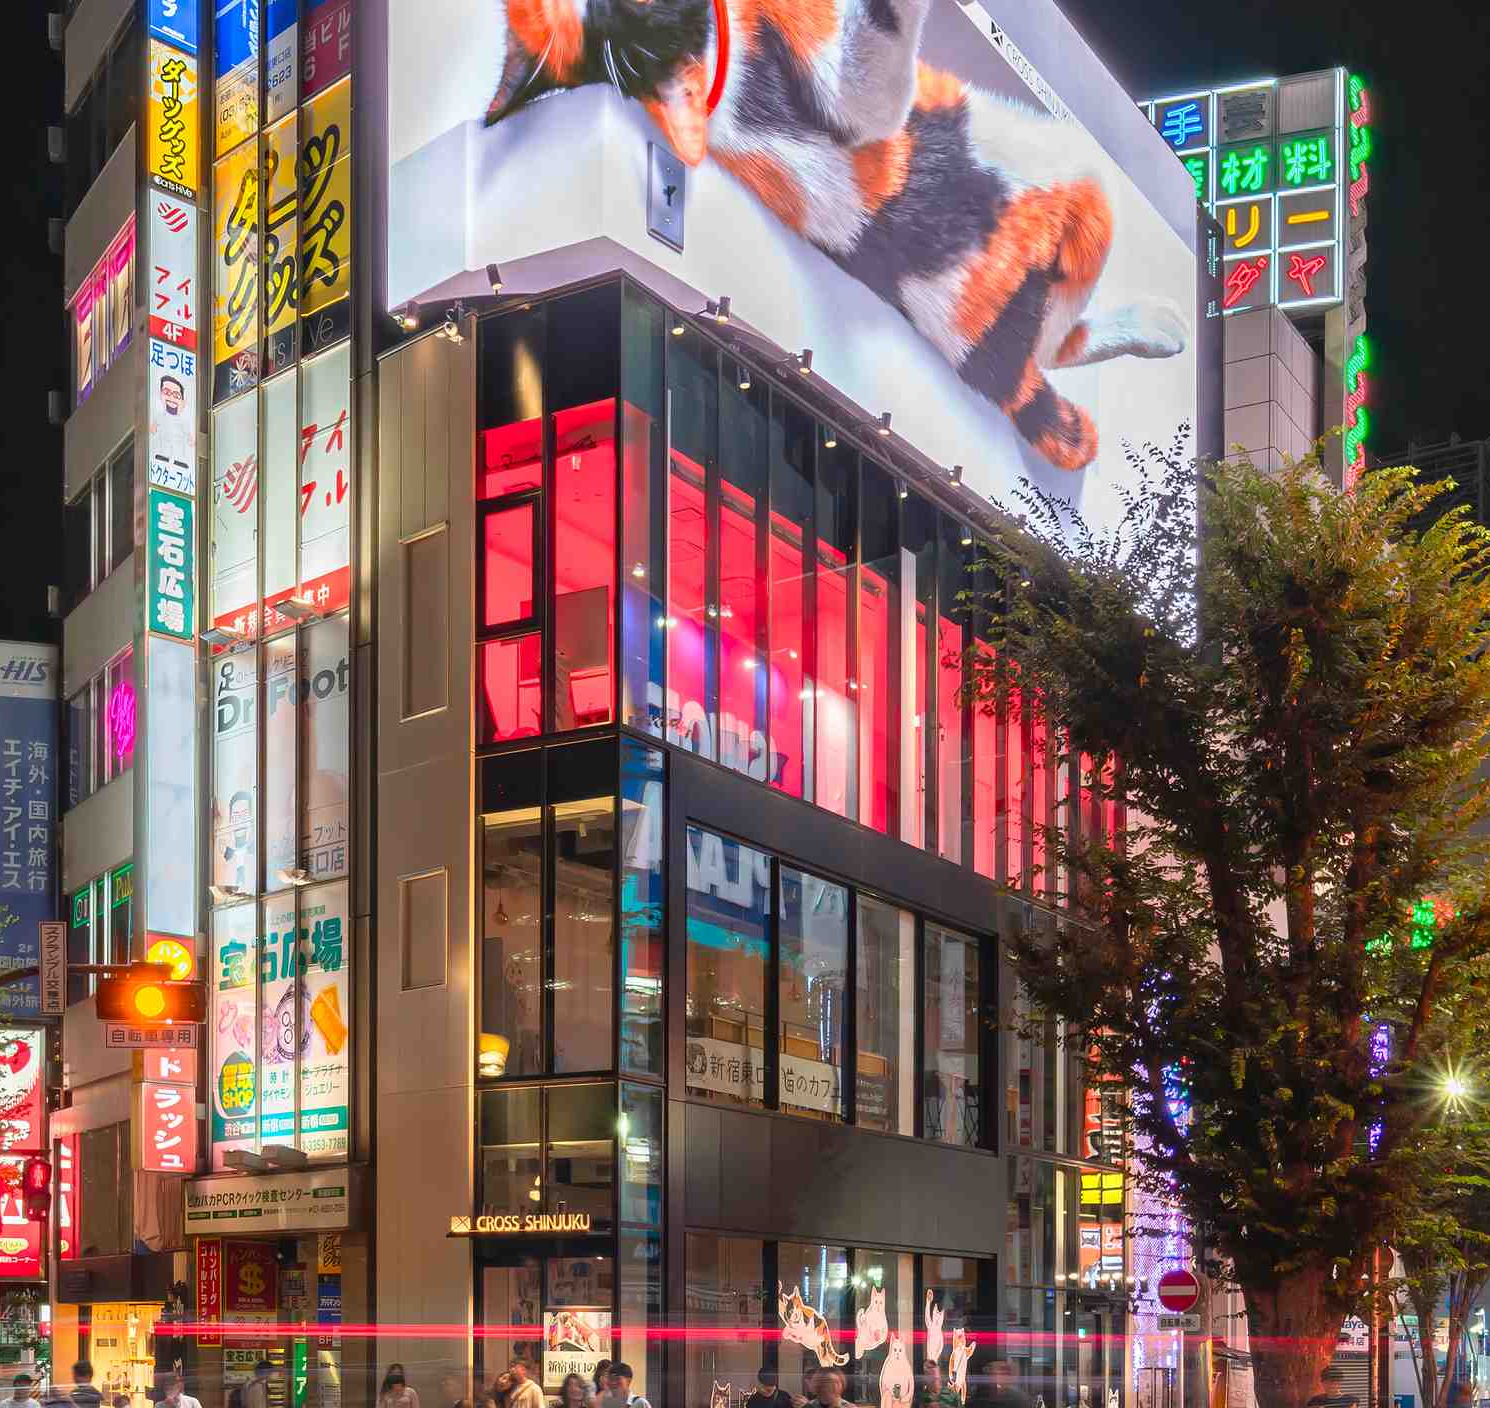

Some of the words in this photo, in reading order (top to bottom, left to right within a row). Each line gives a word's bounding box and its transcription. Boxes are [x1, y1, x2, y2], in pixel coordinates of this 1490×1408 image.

[162, 323, 184, 342] 4F
[156, 501, 186, 634] 宝石広場
[0, 659, 50, 683] HIS
[1, 738, 23, 889] エイチ・アイ・エス
[27, 741, 49, 891] 海外・国内旅行
[476, 1215, 521, 1232] CROSS
[524, 1213, 590, 1232] SHINJUKU
